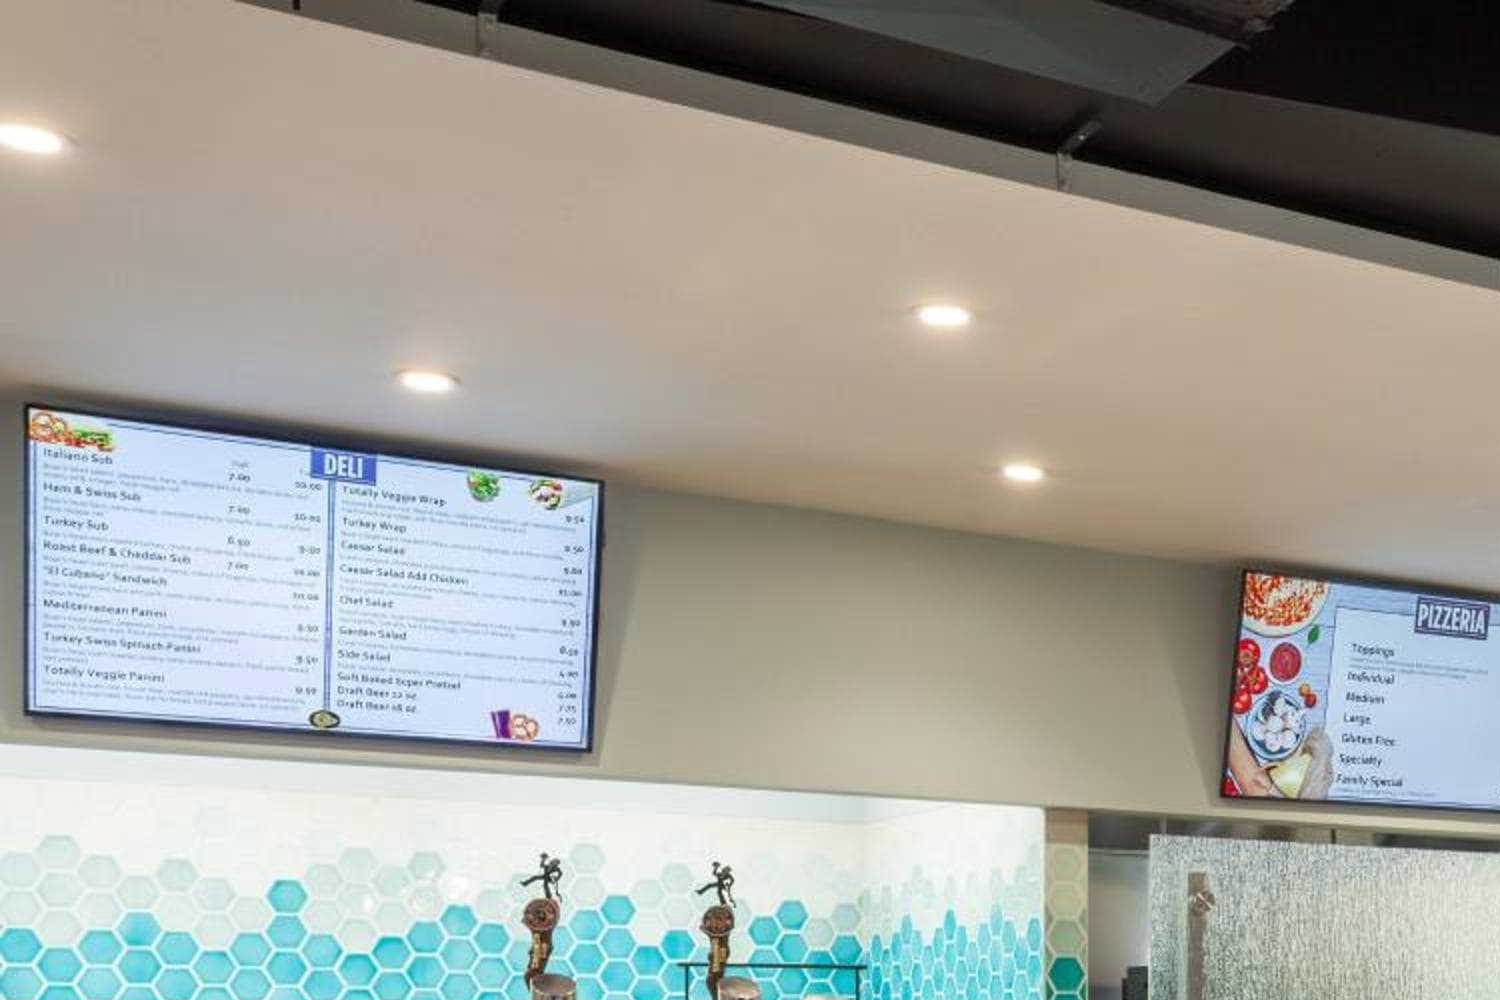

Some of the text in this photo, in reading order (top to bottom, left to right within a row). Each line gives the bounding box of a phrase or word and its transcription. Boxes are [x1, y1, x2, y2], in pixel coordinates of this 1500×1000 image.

[91, 453, 113, 465] Sub
[323, 454, 364, 479] DELI
[43, 482, 72, 495] Ham
[85, 487, 117, 500] Swiss
[120, 491, 141, 503] Sub
[419, 494, 446, 507] Wrap
[43, 516, 84, 531] Turkey
[87, 520, 109, 532] Sub
[343, 517, 407, 533] Turkey Wrap
[43, 541, 76, 554] Roast
[80, 544, 106, 556] Beef
[120, 548, 167, 562] Cheddar
[170, 553, 191, 565] Sub
[341, 541, 406, 555] Caesar Salad
[113, 572, 167, 587] Sandwich
[340, 563, 374, 576] Caesar
[377, 566, 405, 579] Salad
[407, 569, 427, 581] Add
[429, 572, 468, 585] Chicken
[43, 599, 129, 617] Mediterranean
[131, 606, 167, 619] Panini
[340, 595, 364, 607] Chef
[366, 597, 394, 609] Salad
[1417, 603, 1486, 634] PIZZERIA
[339, 626, 407, 641] Garden Salad
[43, 632, 83, 646] Turkey
[85, 635, 117, 648] Swiss
[119, 638, 162, 653] Spinach
[165, 642, 201, 654] Panini
[1352, 643, 1395, 657] Toppings
[338, 649, 360, 660] Side
[362, 651, 391, 662] Salad
[43, 664, 85, 679] Totally
[87, 668, 127, 682] Veggie
[129, 671, 165, 684] Panini
[337, 672, 359, 682] Soft
[361, 673, 393, 684] Baked
[1347, 671, 1395, 685] Individual
[337, 686, 363, 696] Draft
[366, 688, 390, 698] Beer
[1345, 692, 1385, 704] Medium
[337, 700, 364, 710] Draft
[365, 702, 390, 711] Beer
[1343, 713, 1371, 726] Large
[1341, 733, 1395, 747] Gluten Free
[1339, 753, 1382, 767] Specialty
[1336, 773, 1403, 789] Family Special
